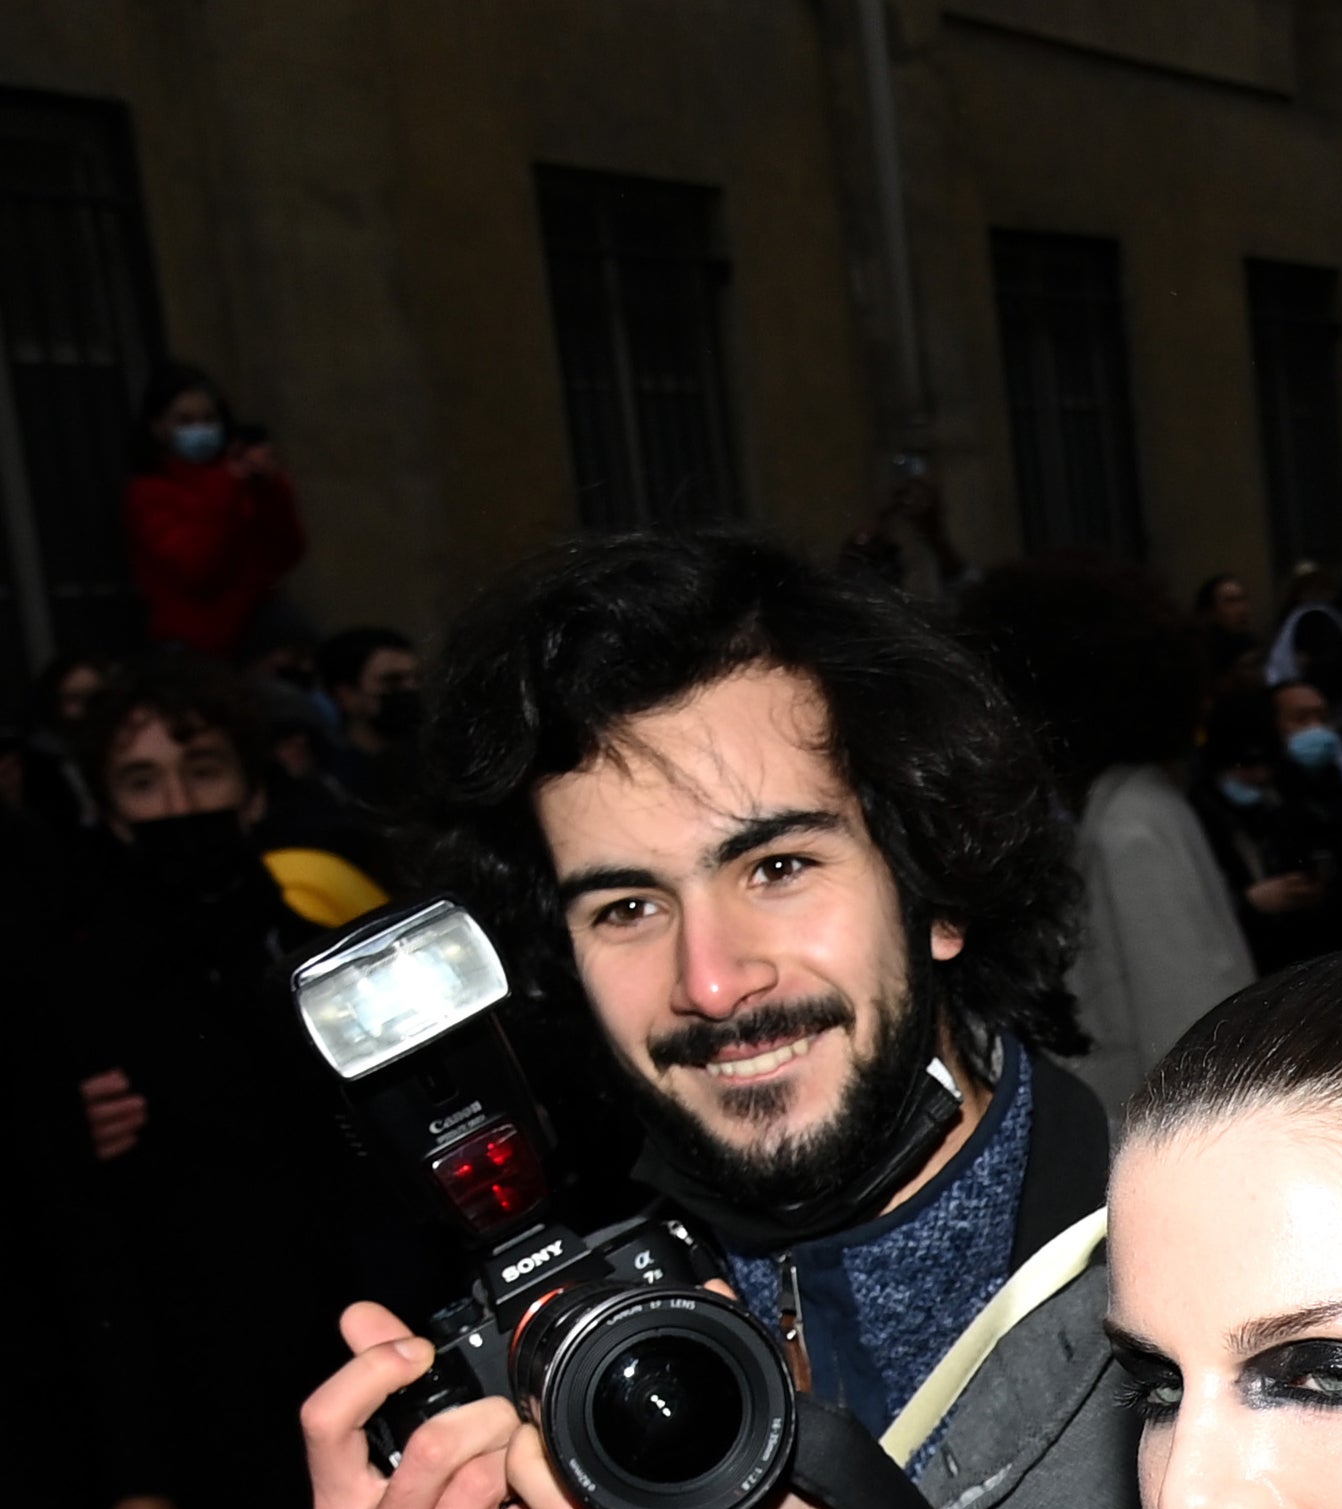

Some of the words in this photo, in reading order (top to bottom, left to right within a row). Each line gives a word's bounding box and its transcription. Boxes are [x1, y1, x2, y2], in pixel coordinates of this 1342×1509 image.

[428, 1099, 483, 1135] Canon
[501, 1239, 563, 1284] SONY
[670, 1298, 696, 1311] LENS
